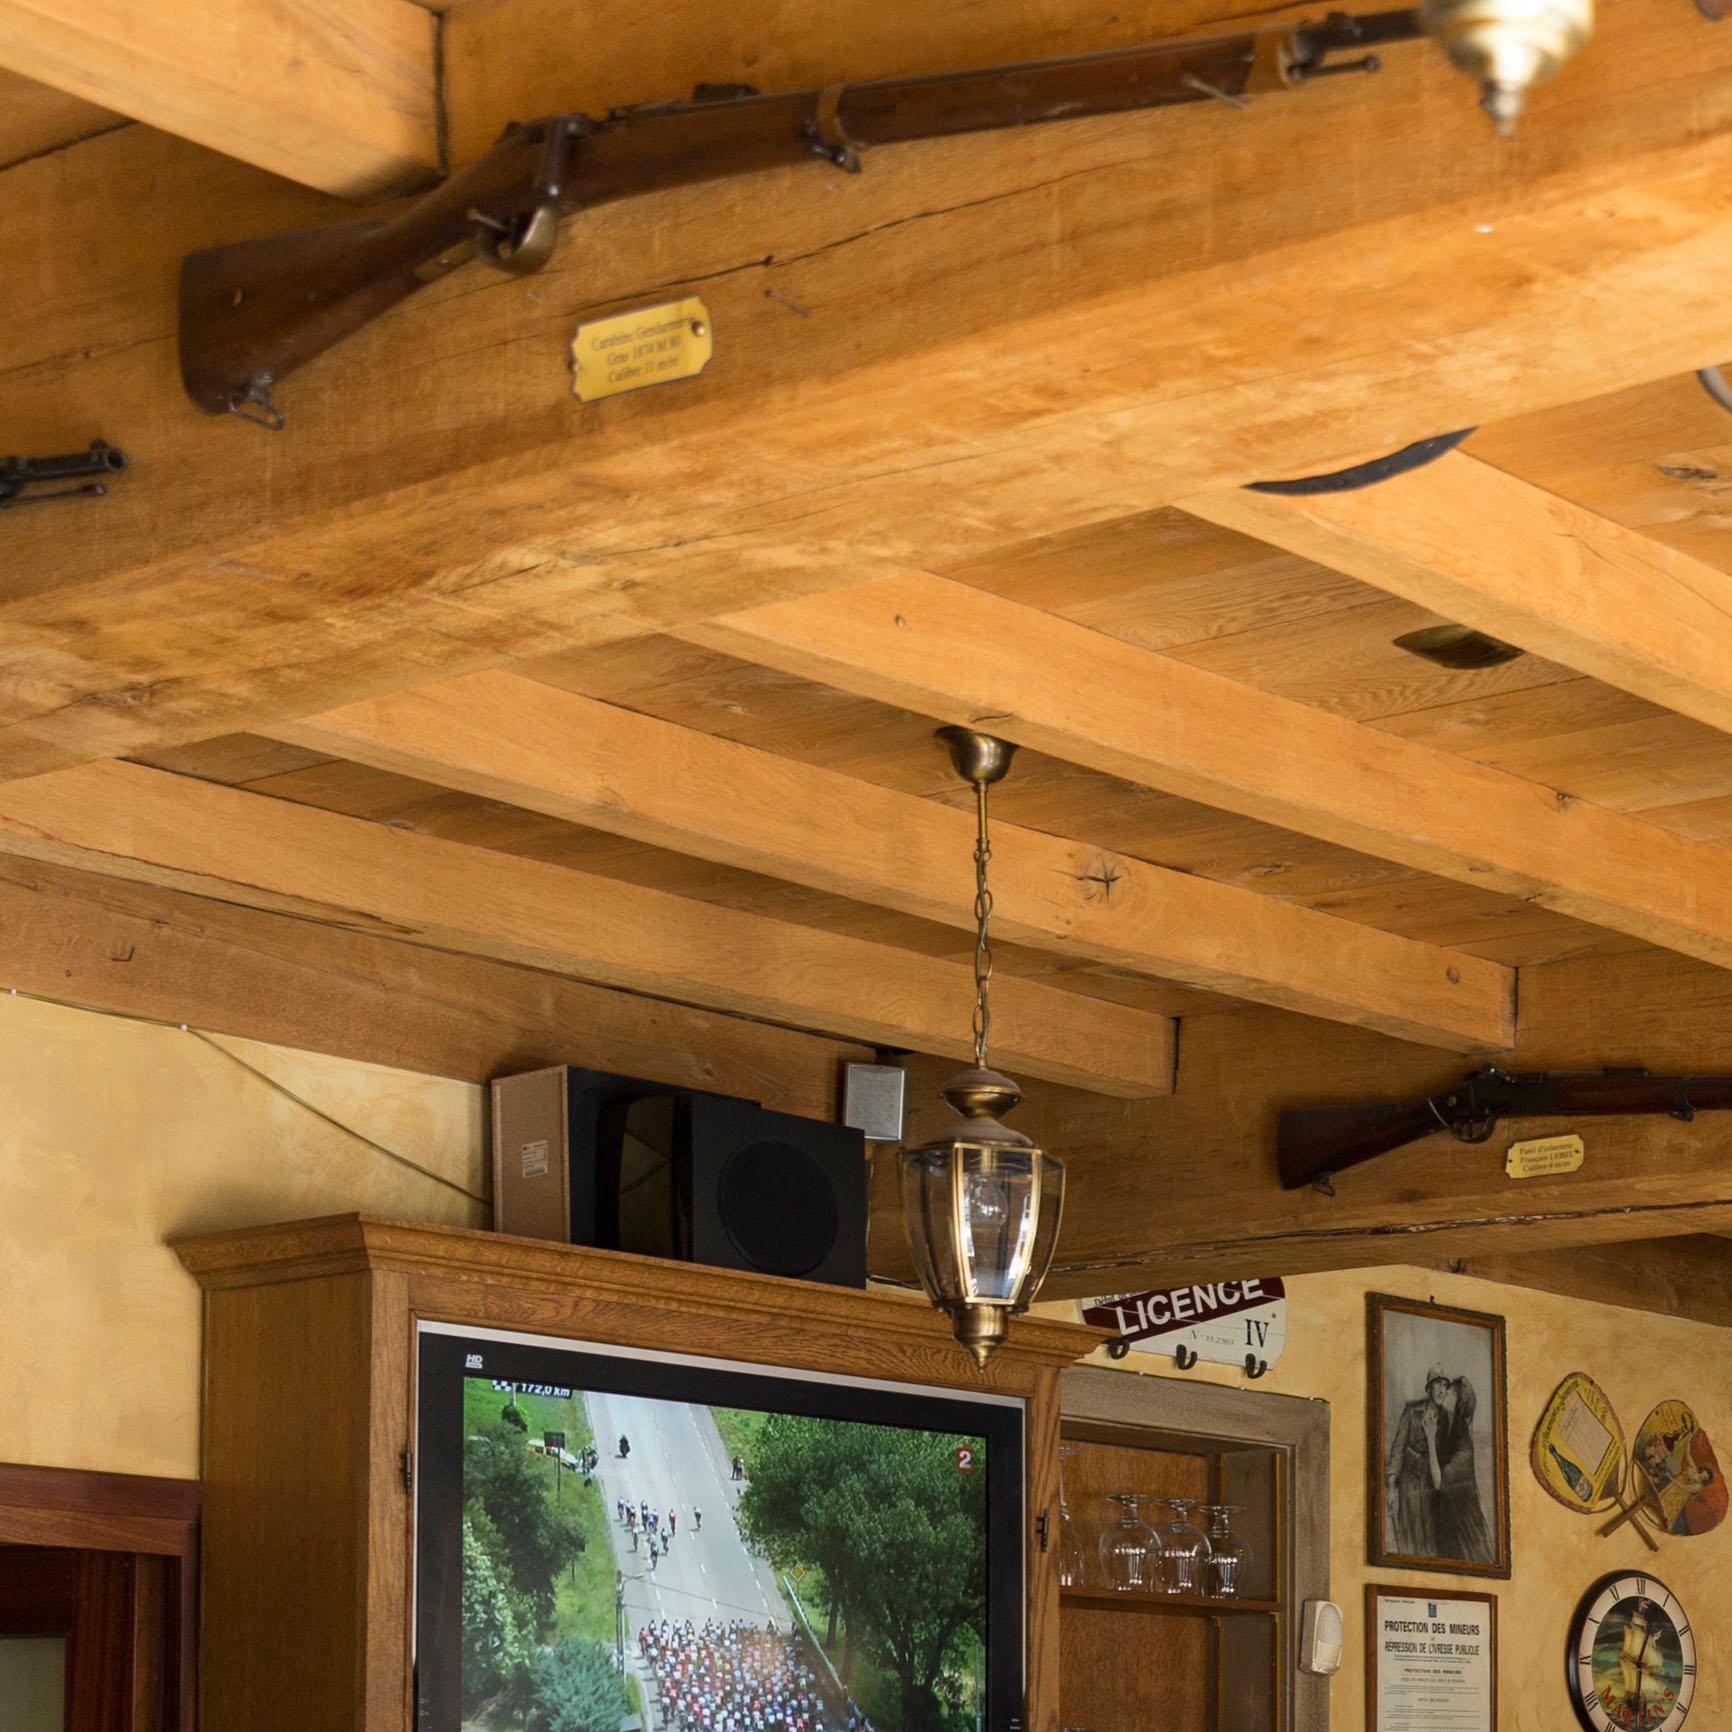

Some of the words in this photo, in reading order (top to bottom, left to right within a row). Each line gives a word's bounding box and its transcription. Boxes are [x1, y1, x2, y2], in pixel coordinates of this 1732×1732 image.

[1115, 1276, 1264, 1337] LICENCE
[1244, 1319, 1269, 1349] IV
[466, 1354, 483, 1363] HD
[554, 1387, 570, 1397] km
[959, 1450, 971, 1469] 2
[1384, 1620, 1429, 1634] PROTECTION
[1431, 1623, 1446, 1634] DES
[1449, 1623, 1480, 1636] MINEURS
